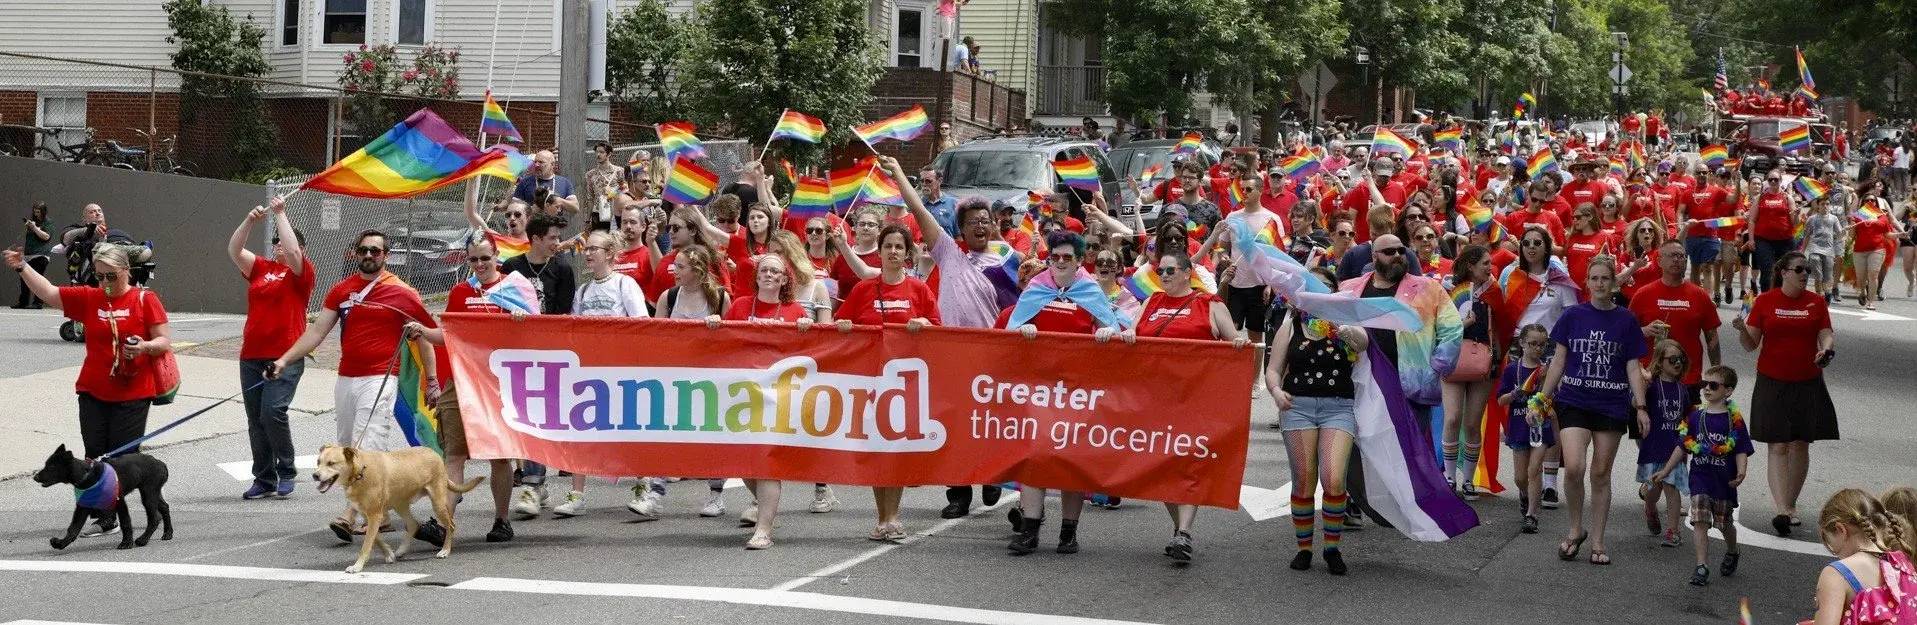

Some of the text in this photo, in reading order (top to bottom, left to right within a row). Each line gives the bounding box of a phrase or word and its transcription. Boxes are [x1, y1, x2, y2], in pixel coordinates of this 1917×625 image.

[1589, 330, 1605, 341] MY
[1577, 363, 1612, 379] ALLY
[1582, 352, 1611, 364] IS AN
[501, 361, 927, 441] Hannaford
[971, 374, 1105, 411] Greater
[970, 409, 1218, 459] than groceries.
